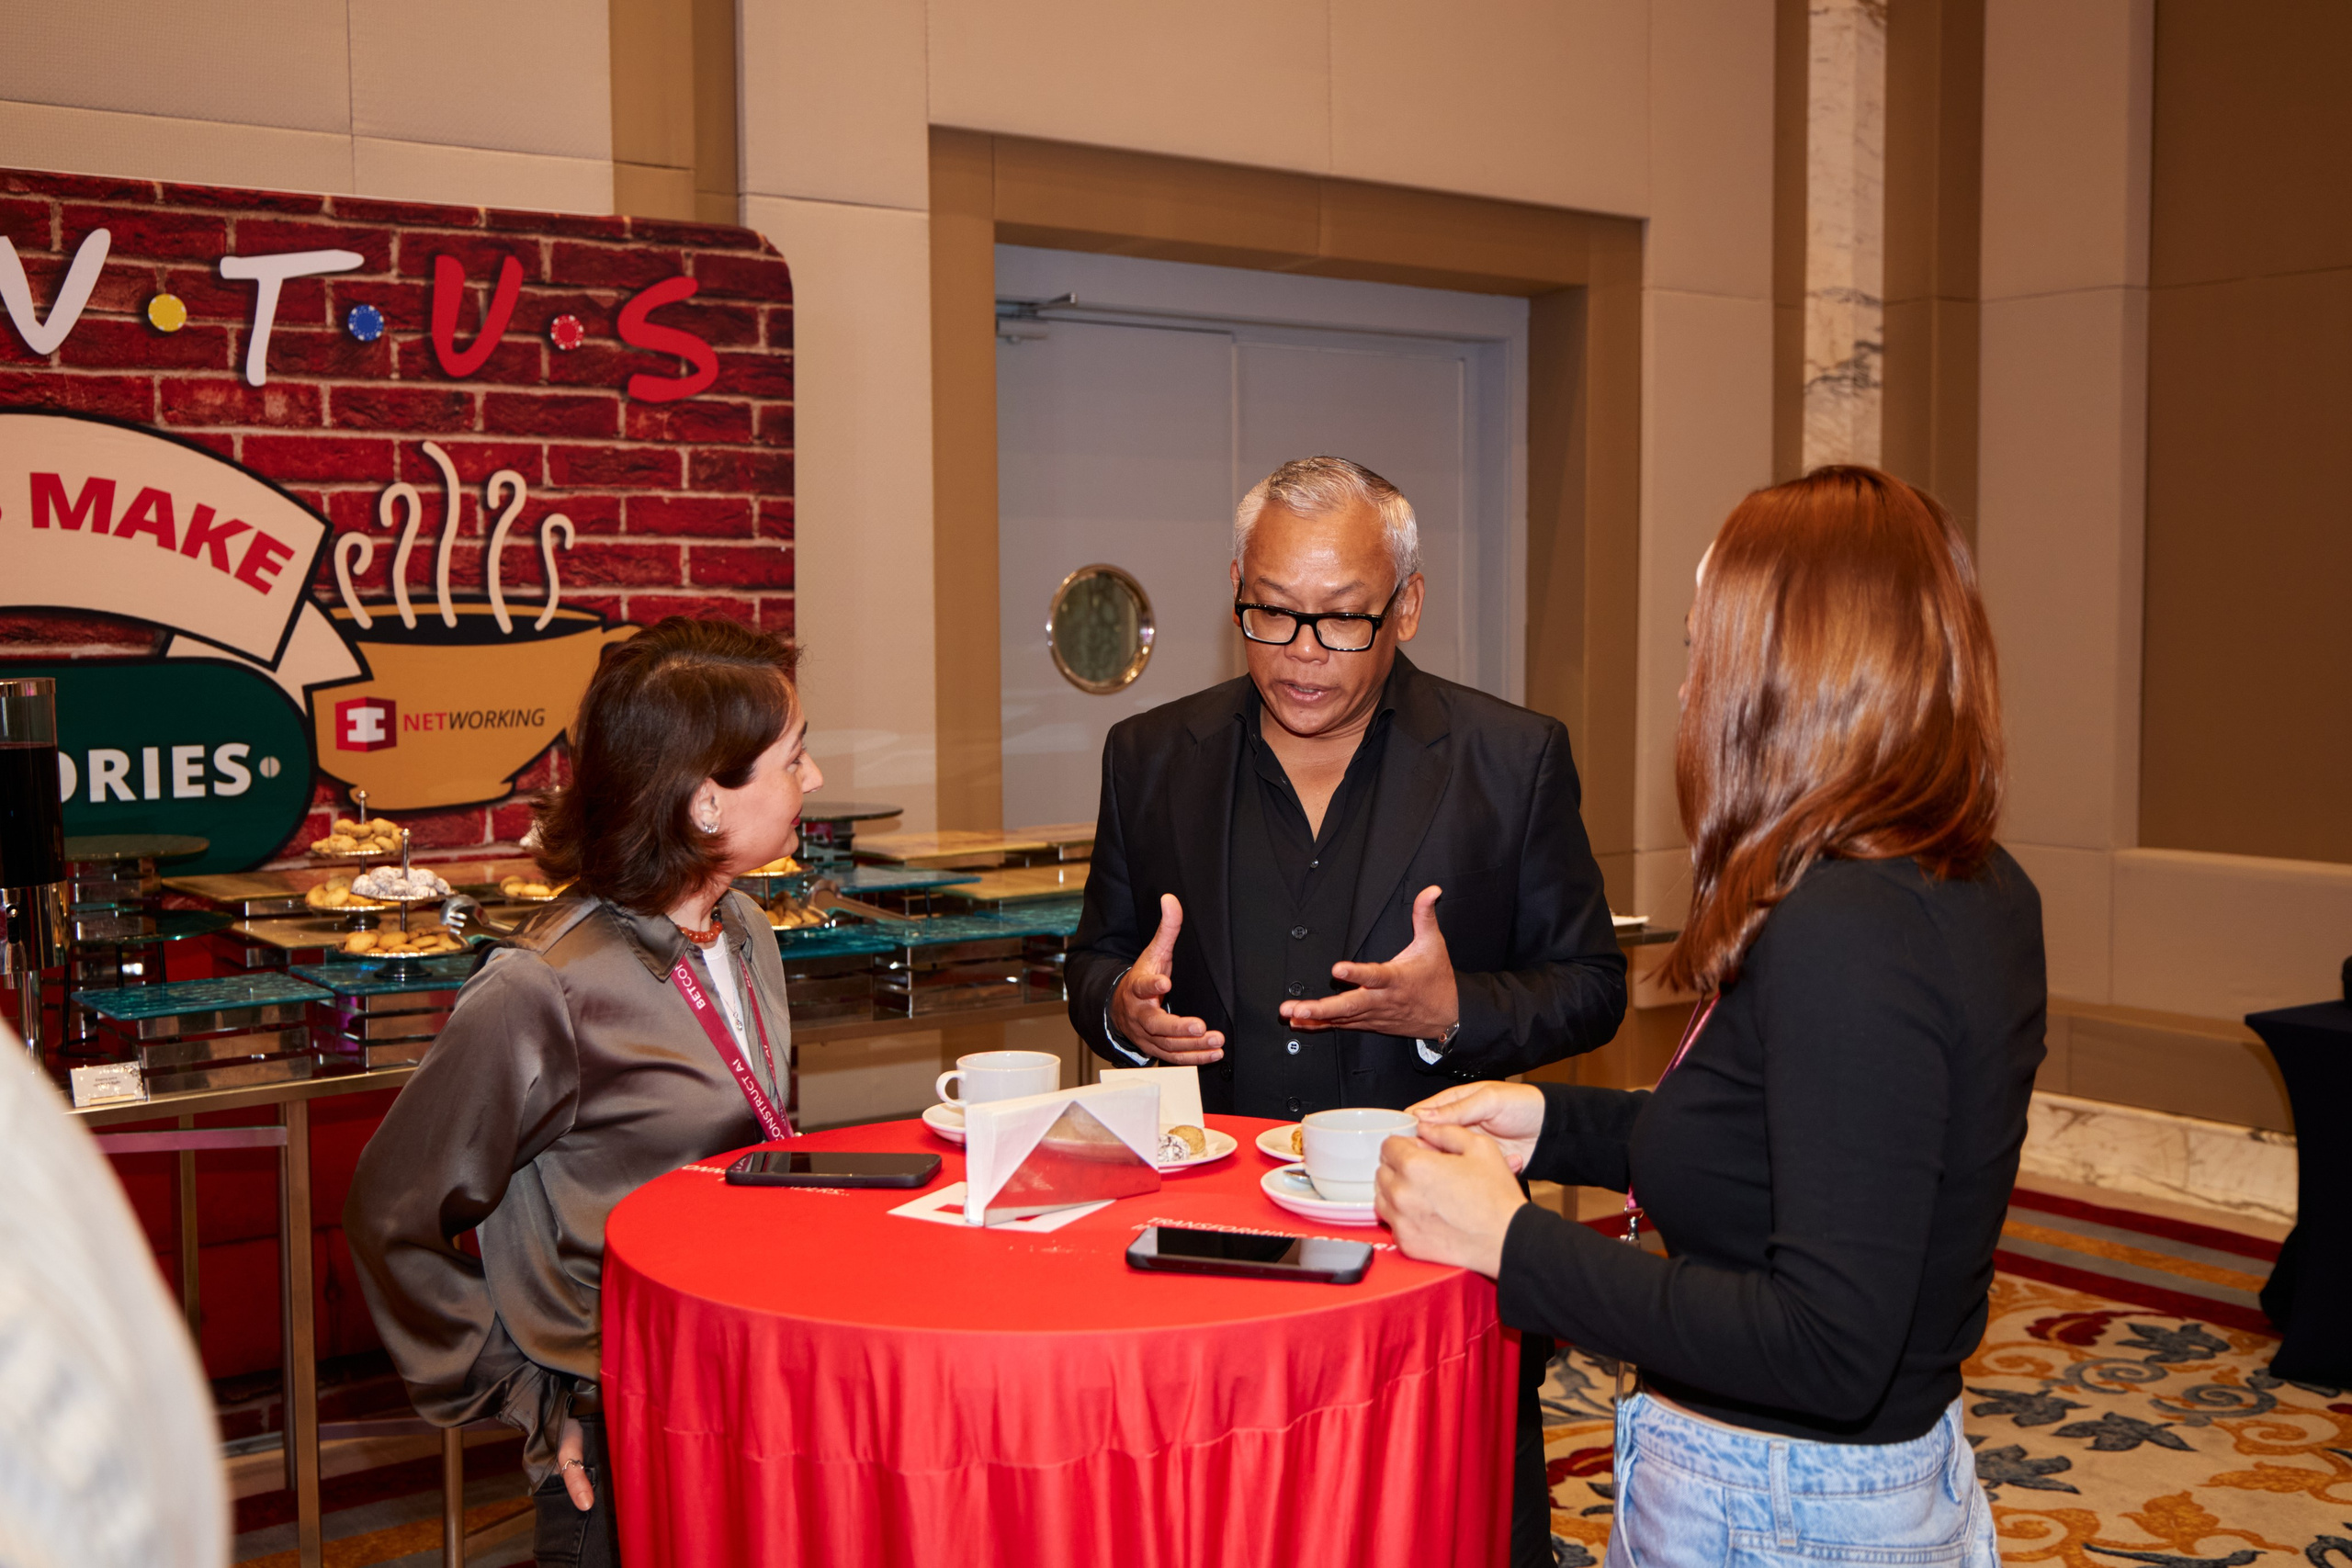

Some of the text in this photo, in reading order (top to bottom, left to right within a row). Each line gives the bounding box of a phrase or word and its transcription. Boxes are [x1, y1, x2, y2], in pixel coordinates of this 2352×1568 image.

[29, 472, 295, 595] MAKE
[403, 707, 546, 732] NETWORKING
[732, 1058, 744, 1072] AI
